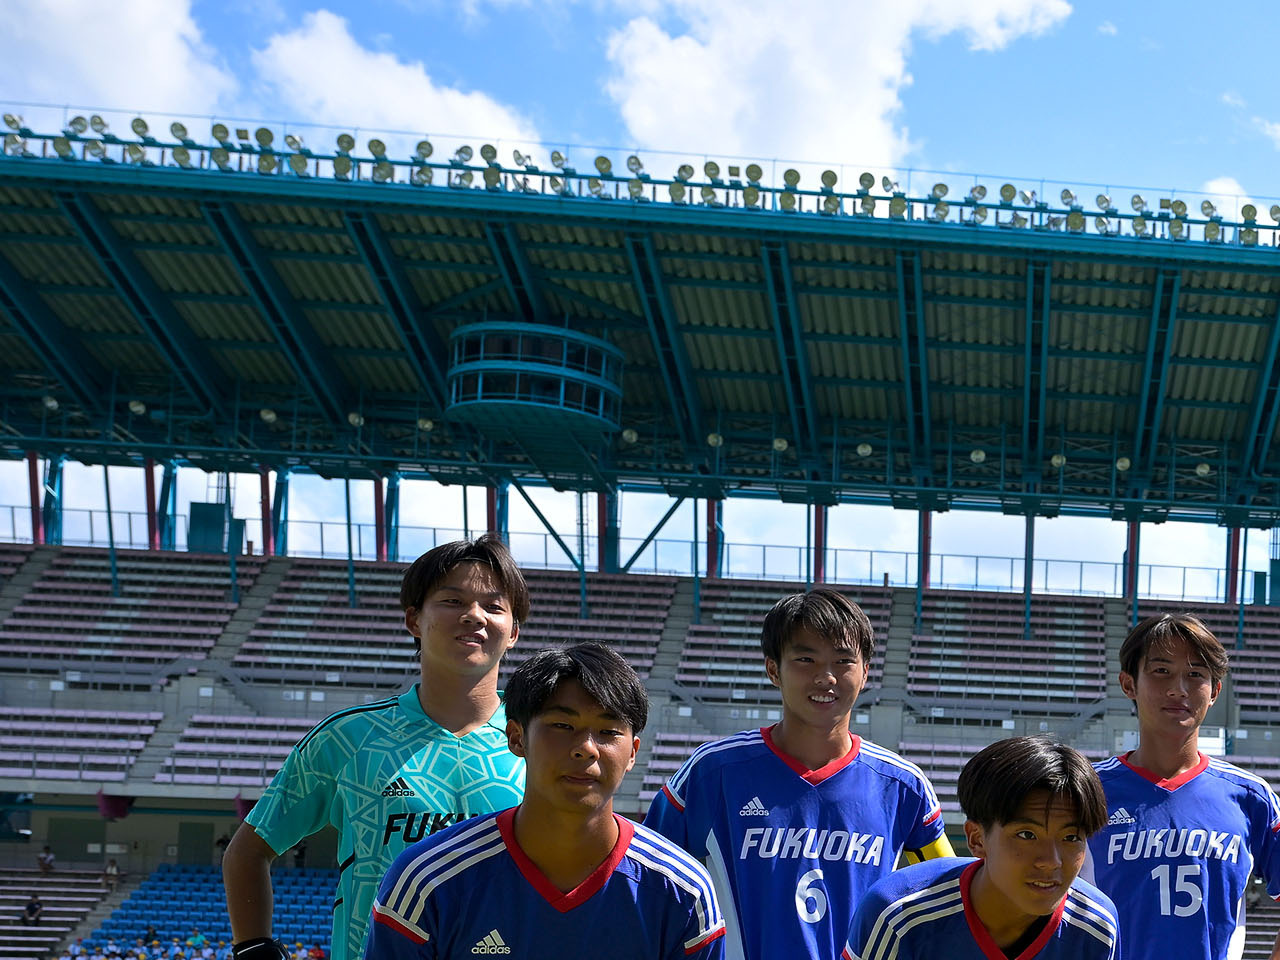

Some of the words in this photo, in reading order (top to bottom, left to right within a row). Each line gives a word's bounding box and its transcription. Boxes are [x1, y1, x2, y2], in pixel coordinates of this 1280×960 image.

[382, 788, 415, 797] adidas
[739, 807, 769, 817] adidas
[1108, 816, 1135, 826] adidas
[740, 826, 885, 867] FUKUOKA
[1107, 828, 1241, 865] FUKUOKA
[795, 868, 827, 924] 6
[1151, 864, 1202, 917] 15
[471, 945, 511, 955] adidas
